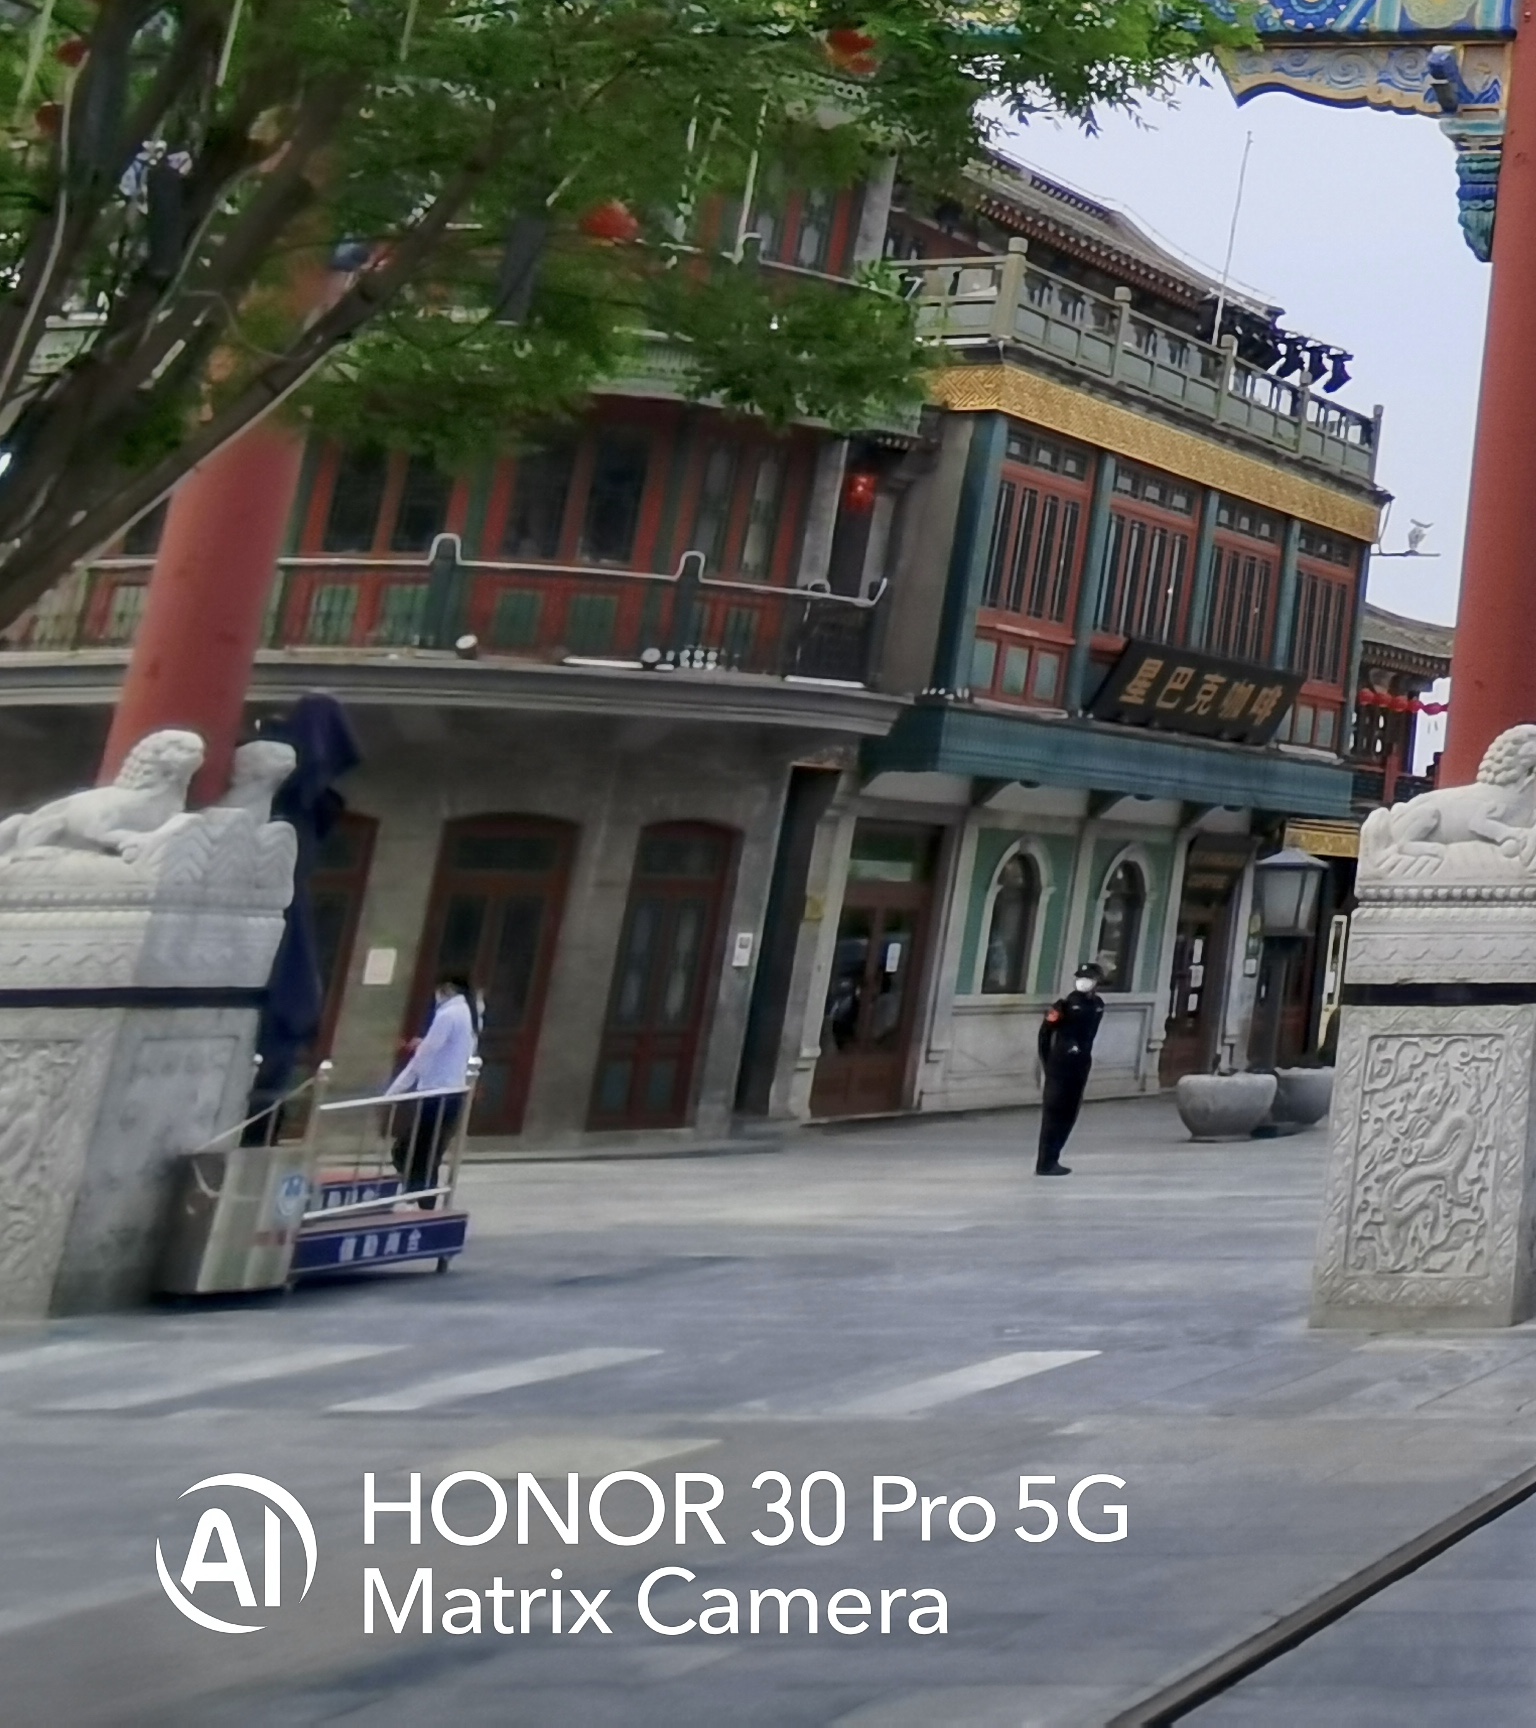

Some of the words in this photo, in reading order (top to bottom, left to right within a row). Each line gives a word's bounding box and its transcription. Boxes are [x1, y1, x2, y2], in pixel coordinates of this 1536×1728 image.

[1118, 657, 1284, 726] 星巴克咖啡
